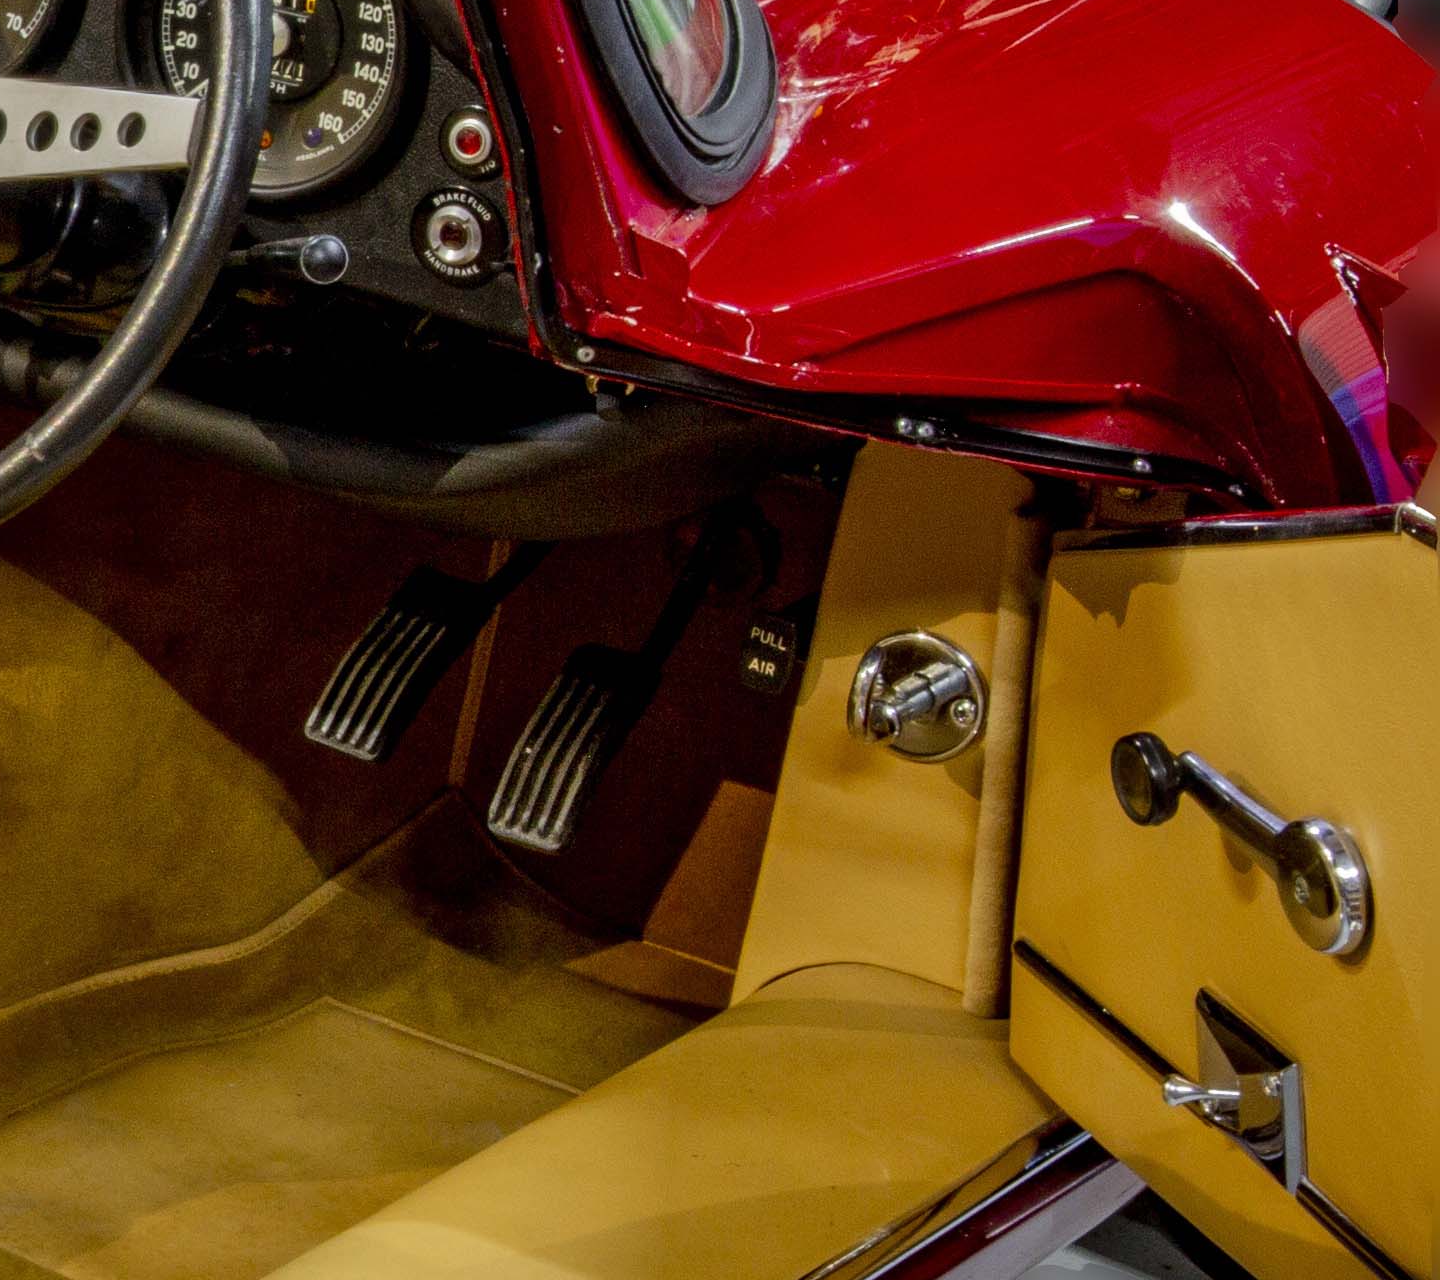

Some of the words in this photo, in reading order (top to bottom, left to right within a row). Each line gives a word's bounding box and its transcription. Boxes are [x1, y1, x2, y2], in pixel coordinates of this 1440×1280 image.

[176, 1, 197, 19] 30
[358, 3, 383, 23] 120
[6, 13, 23, 32] 70
[176, 31, 198, 48] 20
[361, 33, 385, 54] 130
[183, 63, 199, 80] 10
[354, 61, 380, 82] 140
[342, 89, 365, 110] 150
[318, 111, 344, 132] 160
[433, 192, 467, 207] BRAKE
[467, 194, 492, 222] FLUID
[423, 249, 480, 277] HANDBRAKE
[750, 626, 787, 652] PULL
[747, 657, 776, 678] AIR
